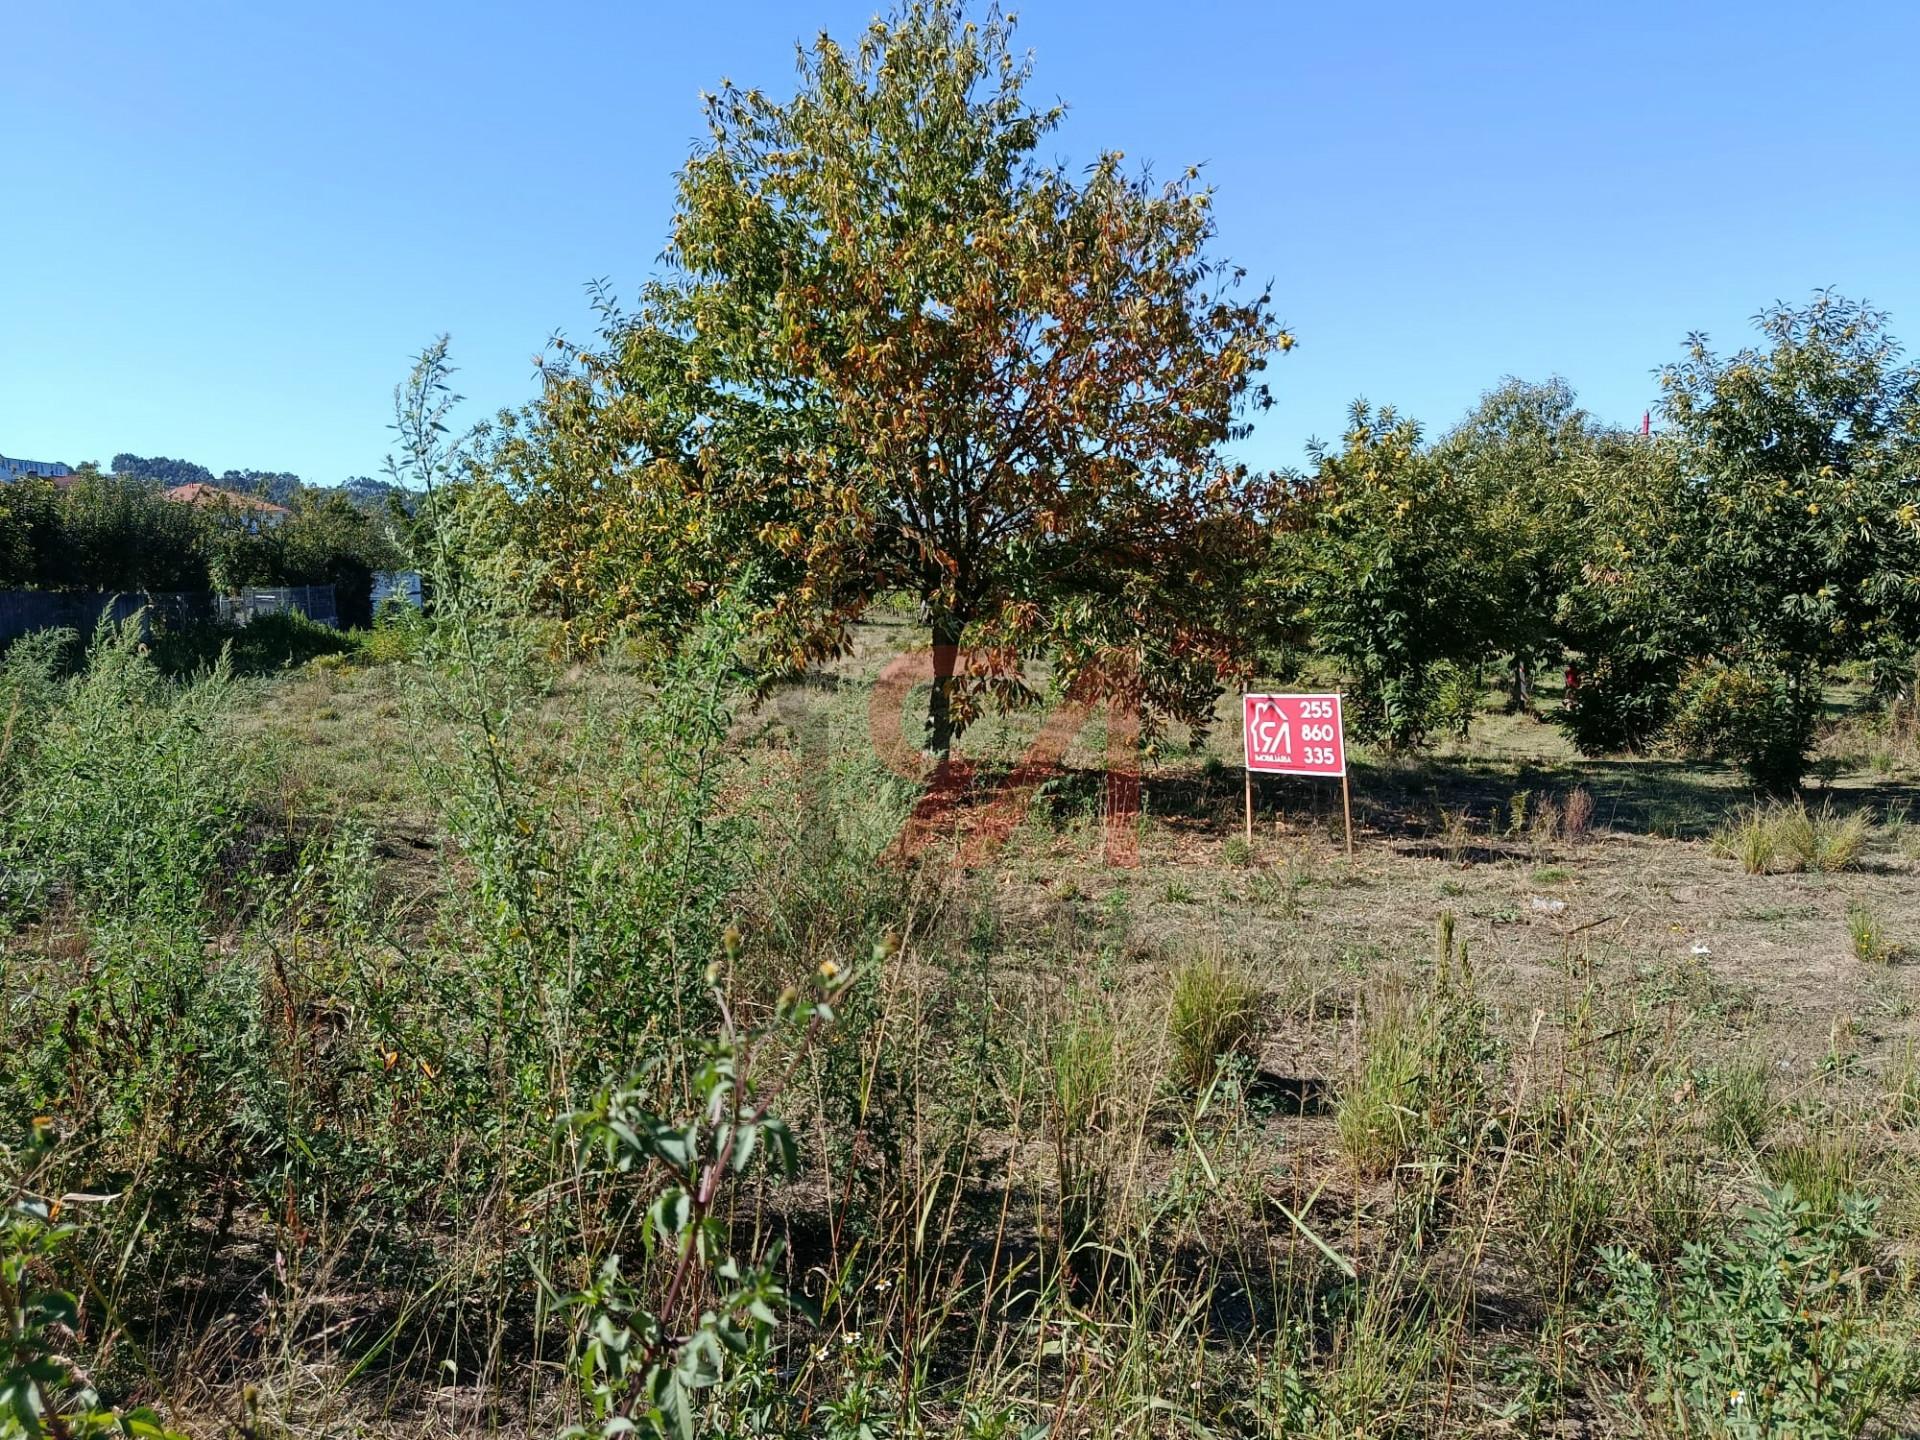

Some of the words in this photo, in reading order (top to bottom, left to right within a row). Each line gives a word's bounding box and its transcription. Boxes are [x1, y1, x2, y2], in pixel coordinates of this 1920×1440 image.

[1299, 701, 1333, 718] 255
[1301, 724, 1334, 742] 860
[1303, 746, 1335, 764] 335
